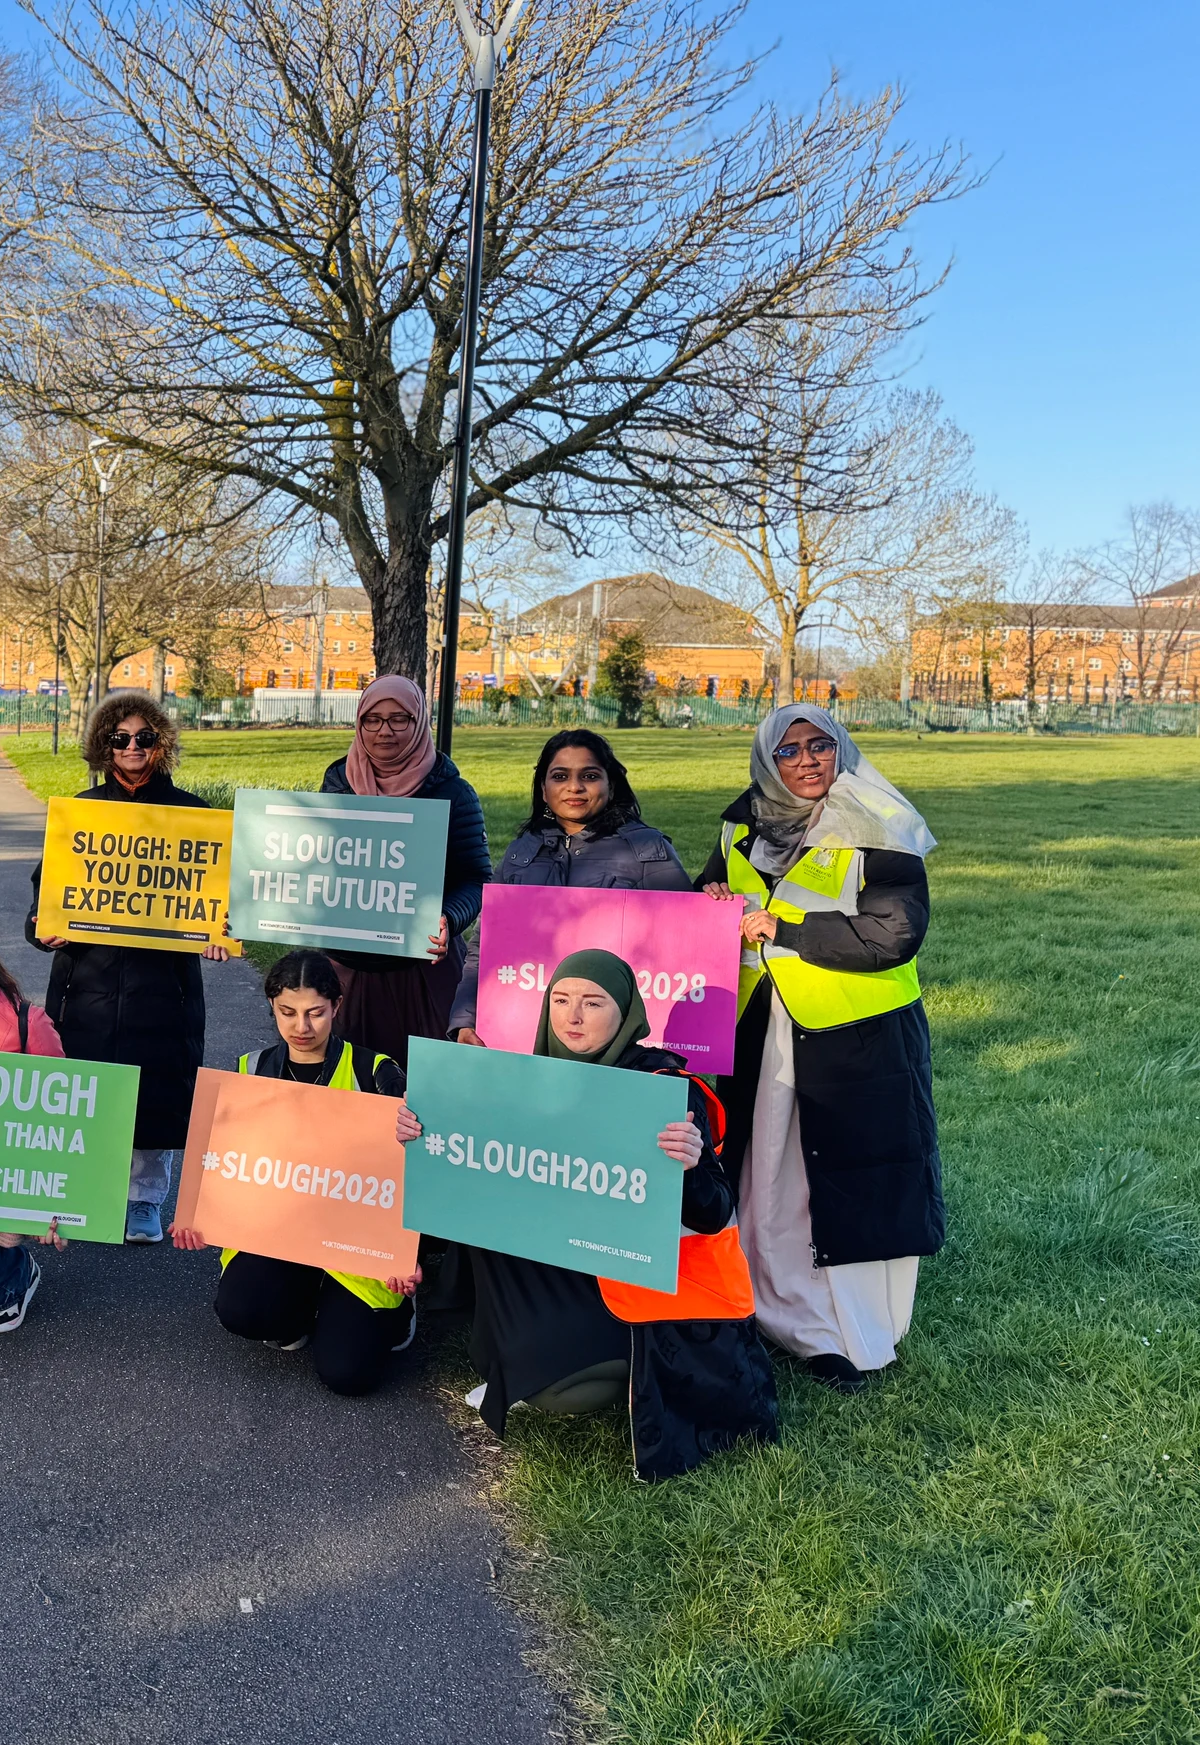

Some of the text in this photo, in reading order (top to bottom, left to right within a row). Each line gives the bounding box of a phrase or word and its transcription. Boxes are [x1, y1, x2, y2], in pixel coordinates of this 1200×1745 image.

[72, 831, 222, 865] SLOUGH: BET
[263, 831, 406, 869] SLOUGH IS
[84, 859, 206, 892] YOU DIDNT
[249, 870, 417, 915] THE FUTURE
[62, 886, 222, 922] EXPECT THAT
[498, 962, 706, 1004] #SL2028
[4, 1121, 64, 1152] THAN
[68, 1128, 85, 1154] A
[202, 1150, 396, 1209] #SLOUGH2028
[424, 1132, 648, 1204] #SLOUGH2028
[322, 1240, 394, 1260] #UKTOWNOFCULTURE2028
[568, 1238, 652, 1263] #UKTOWNOFCULTURE2028
